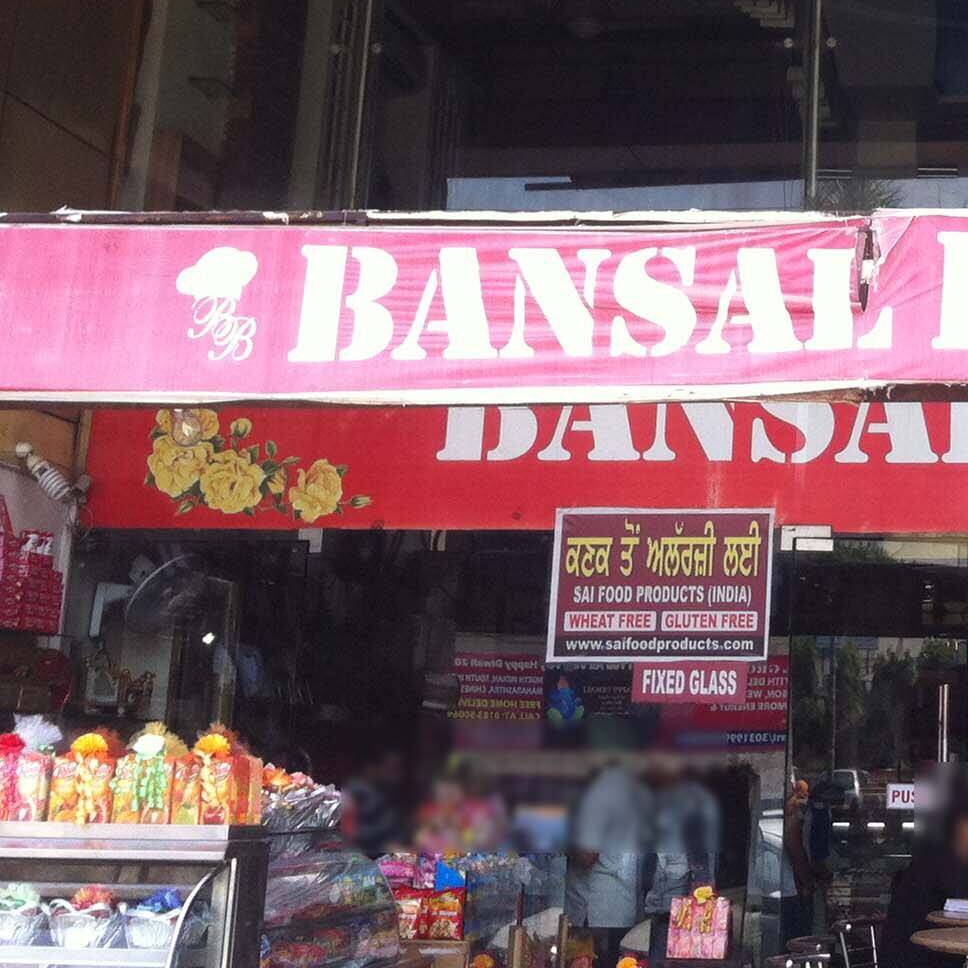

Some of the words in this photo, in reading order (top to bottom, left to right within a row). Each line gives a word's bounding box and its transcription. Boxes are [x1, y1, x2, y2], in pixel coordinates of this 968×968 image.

[287, 244, 893, 363] BANSAL
[565, 537, 613, 577] ਕਣਕ
[723, 520, 762, 577] ਲਈ
[573, 587, 594, 603] SAI
[598, 587, 632, 602] FOOD
[636, 586, 704, 603] PRODUCTS
[707, 586, 752, 607] (INDIA)
[569, 614, 614, 628] WHEAT
[618, 614, 651, 628] FREE
[665, 614, 717, 628] GLUTEN
[721, 614, 754, 628] FREE
[566, 637, 754, 653] www.saifoodproducts.com
[642, 669, 685, 695] FIXED
[689, 670, 737, 695] GLASS
